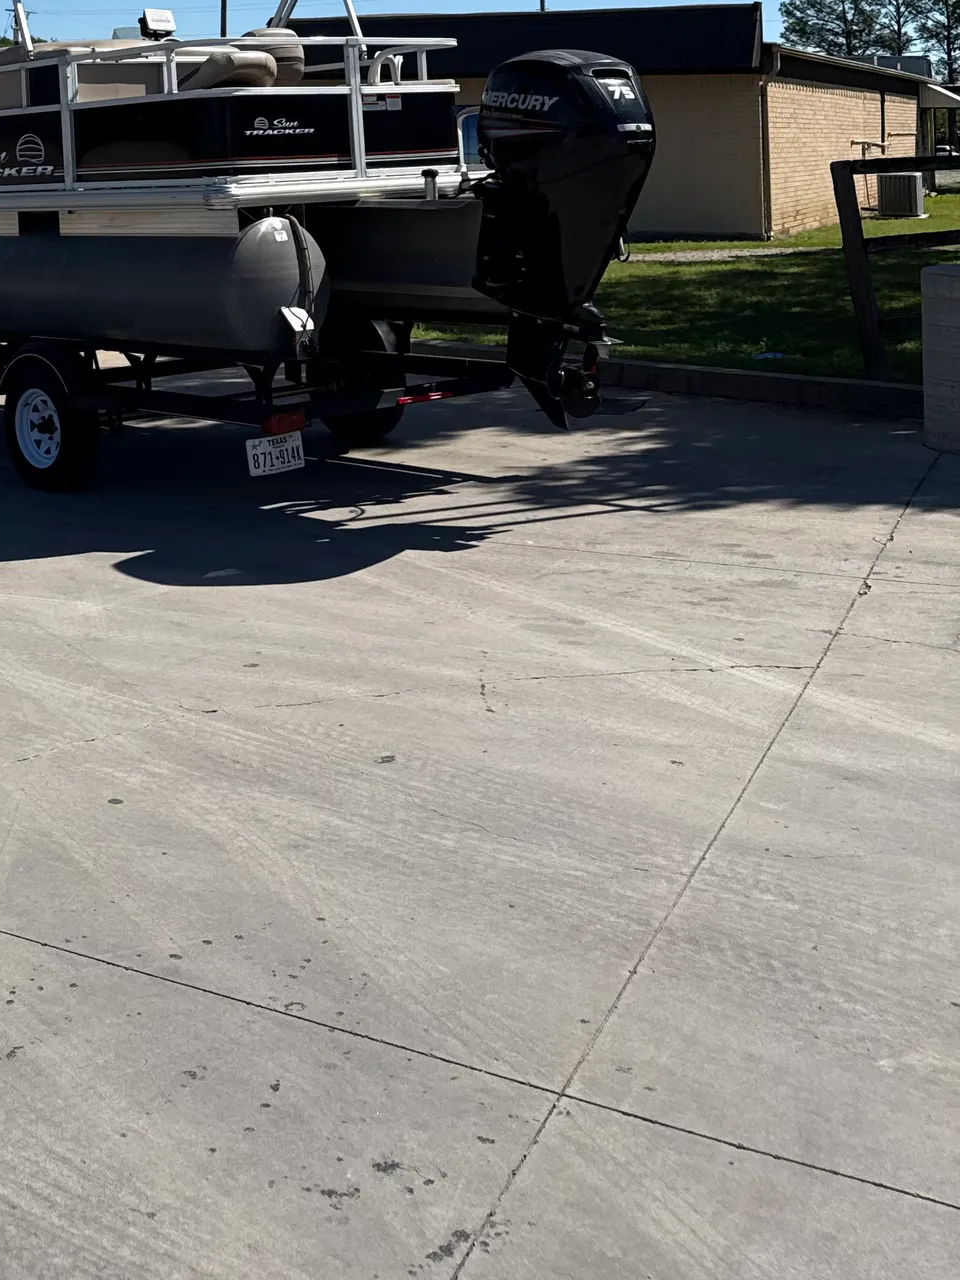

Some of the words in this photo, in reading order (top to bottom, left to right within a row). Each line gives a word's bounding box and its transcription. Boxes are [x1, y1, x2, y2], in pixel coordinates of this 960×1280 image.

[607, 86, 635, 99] 75
[482, 91, 560, 111] MERCURY
[270, 117, 299, 128] Sun
[244, 128, 315, 136] TRACKER
[267, 436, 287, 446] TEXAS
